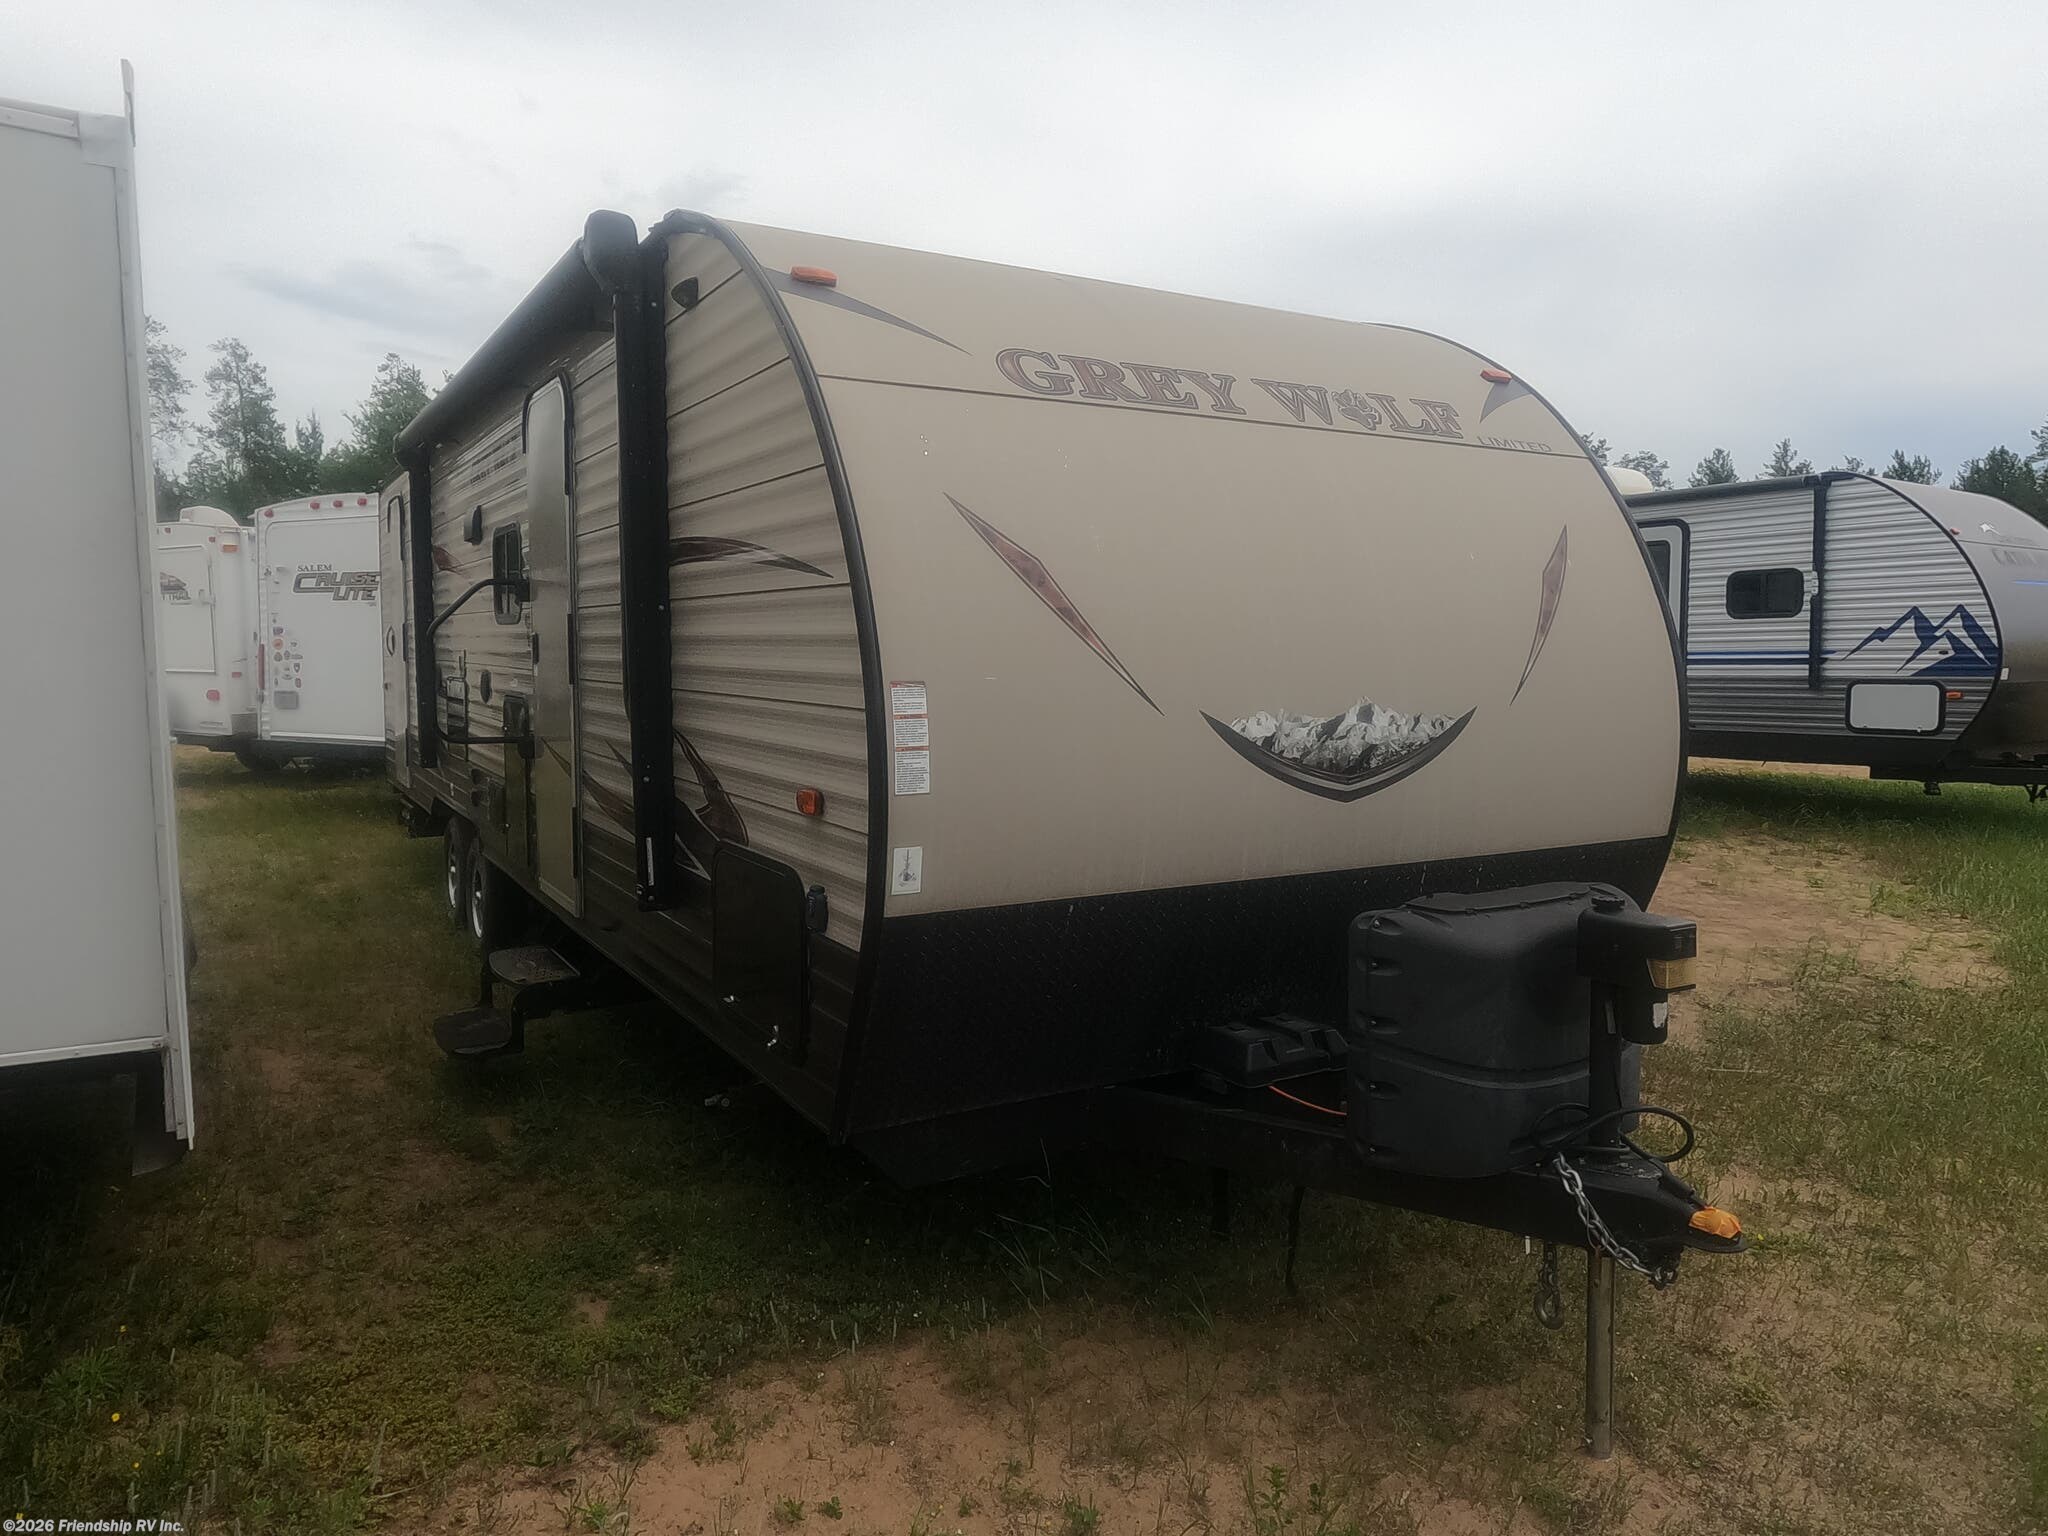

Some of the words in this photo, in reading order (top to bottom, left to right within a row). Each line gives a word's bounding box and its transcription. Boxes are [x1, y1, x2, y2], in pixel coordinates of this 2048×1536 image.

[995, 348, 1247, 415] GREY
[1476, 436, 1552, 452] LIMITED
[297, 564, 332, 572] SALEM
[293, 571, 380, 593] CRUISE
[332, 586, 378, 601] LITE
